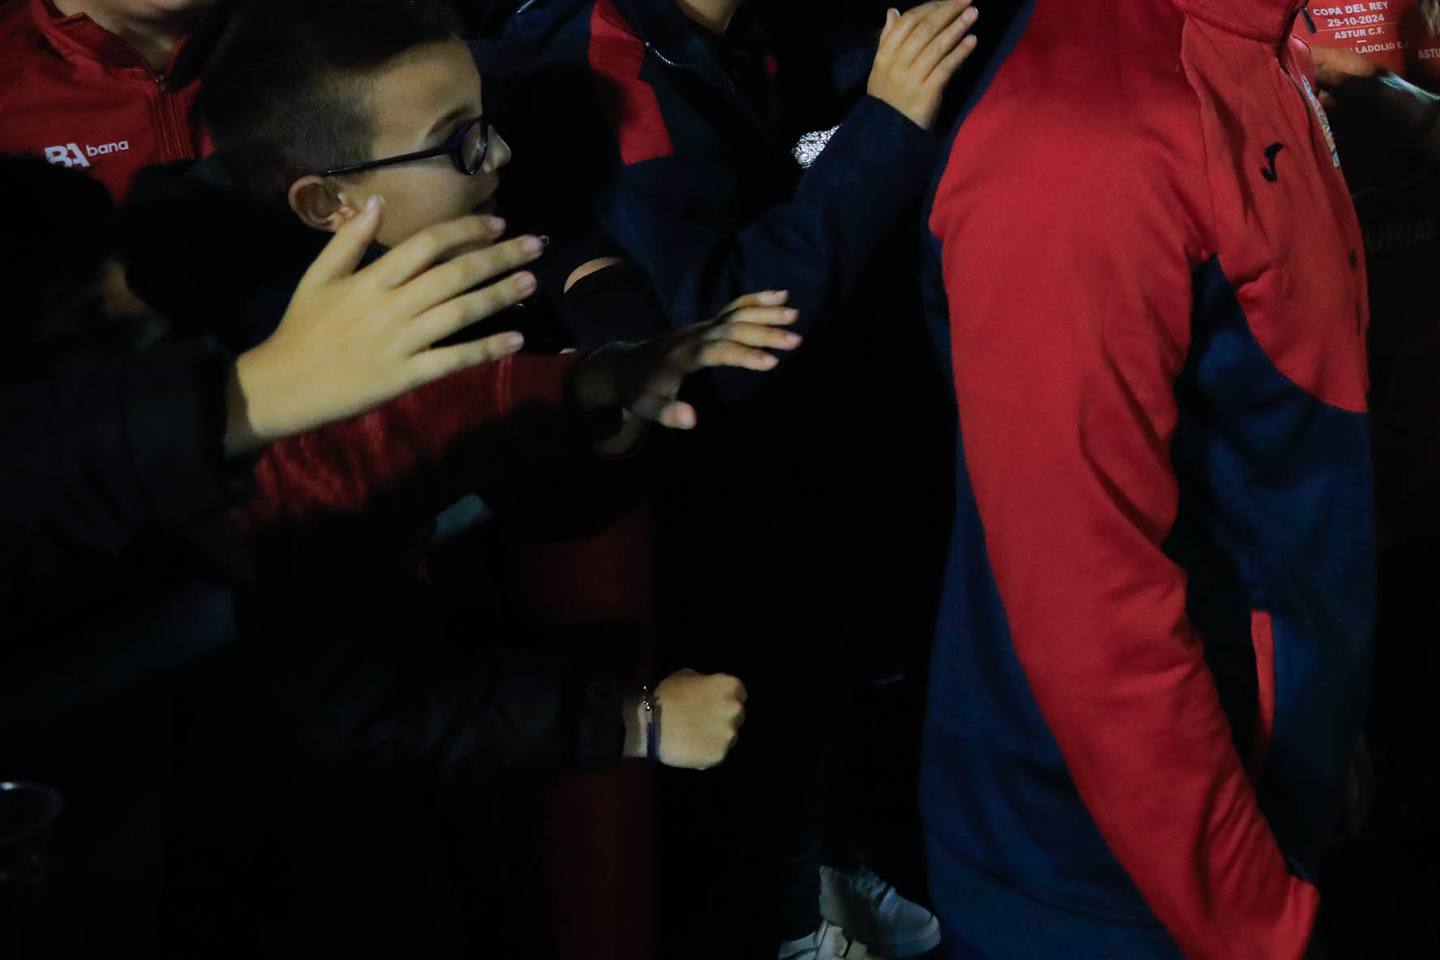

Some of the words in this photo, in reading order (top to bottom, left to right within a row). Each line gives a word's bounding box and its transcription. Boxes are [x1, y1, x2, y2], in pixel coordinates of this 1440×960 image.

[1312, 6, 1343, 17] COPA
[1345, 3, 1368, 15] DEL
[1369, 0, 1390, 12] REY
[1327, 14, 1385, 28] 29-10-2024
[1334, 29, 1366, 40] ASTUR
[1353, 43, 1396, 55] LADOLID
[86, 140, 129, 157] bana
[1366, 216, 1438, 252] URIAS
